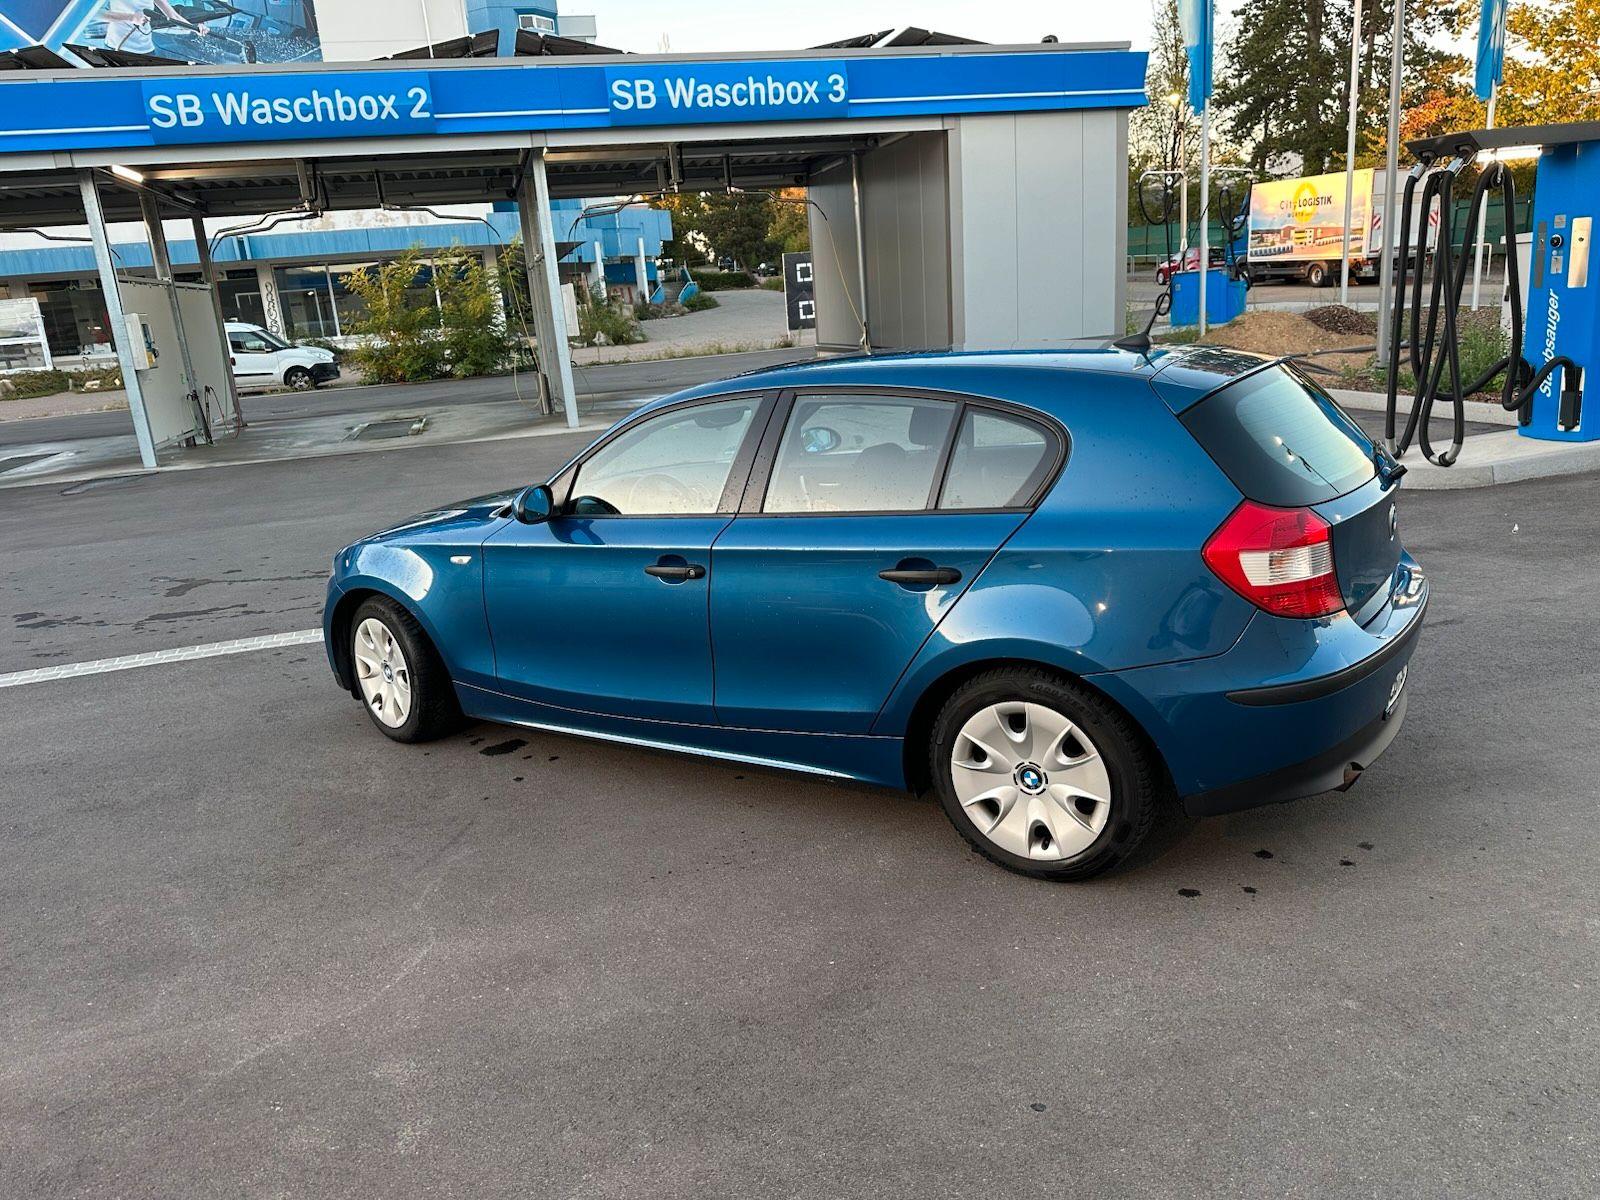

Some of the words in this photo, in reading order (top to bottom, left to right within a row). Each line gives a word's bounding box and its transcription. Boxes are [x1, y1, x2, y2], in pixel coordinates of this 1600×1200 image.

[150, 94, 204, 128] SB
[212, 88, 400, 126] Waschbox
[407, 87, 430, 119] 2
[611, 79, 657, 110] SB
[664, 75, 820, 109] Waschbox
[827, 74, 846, 103] 3
